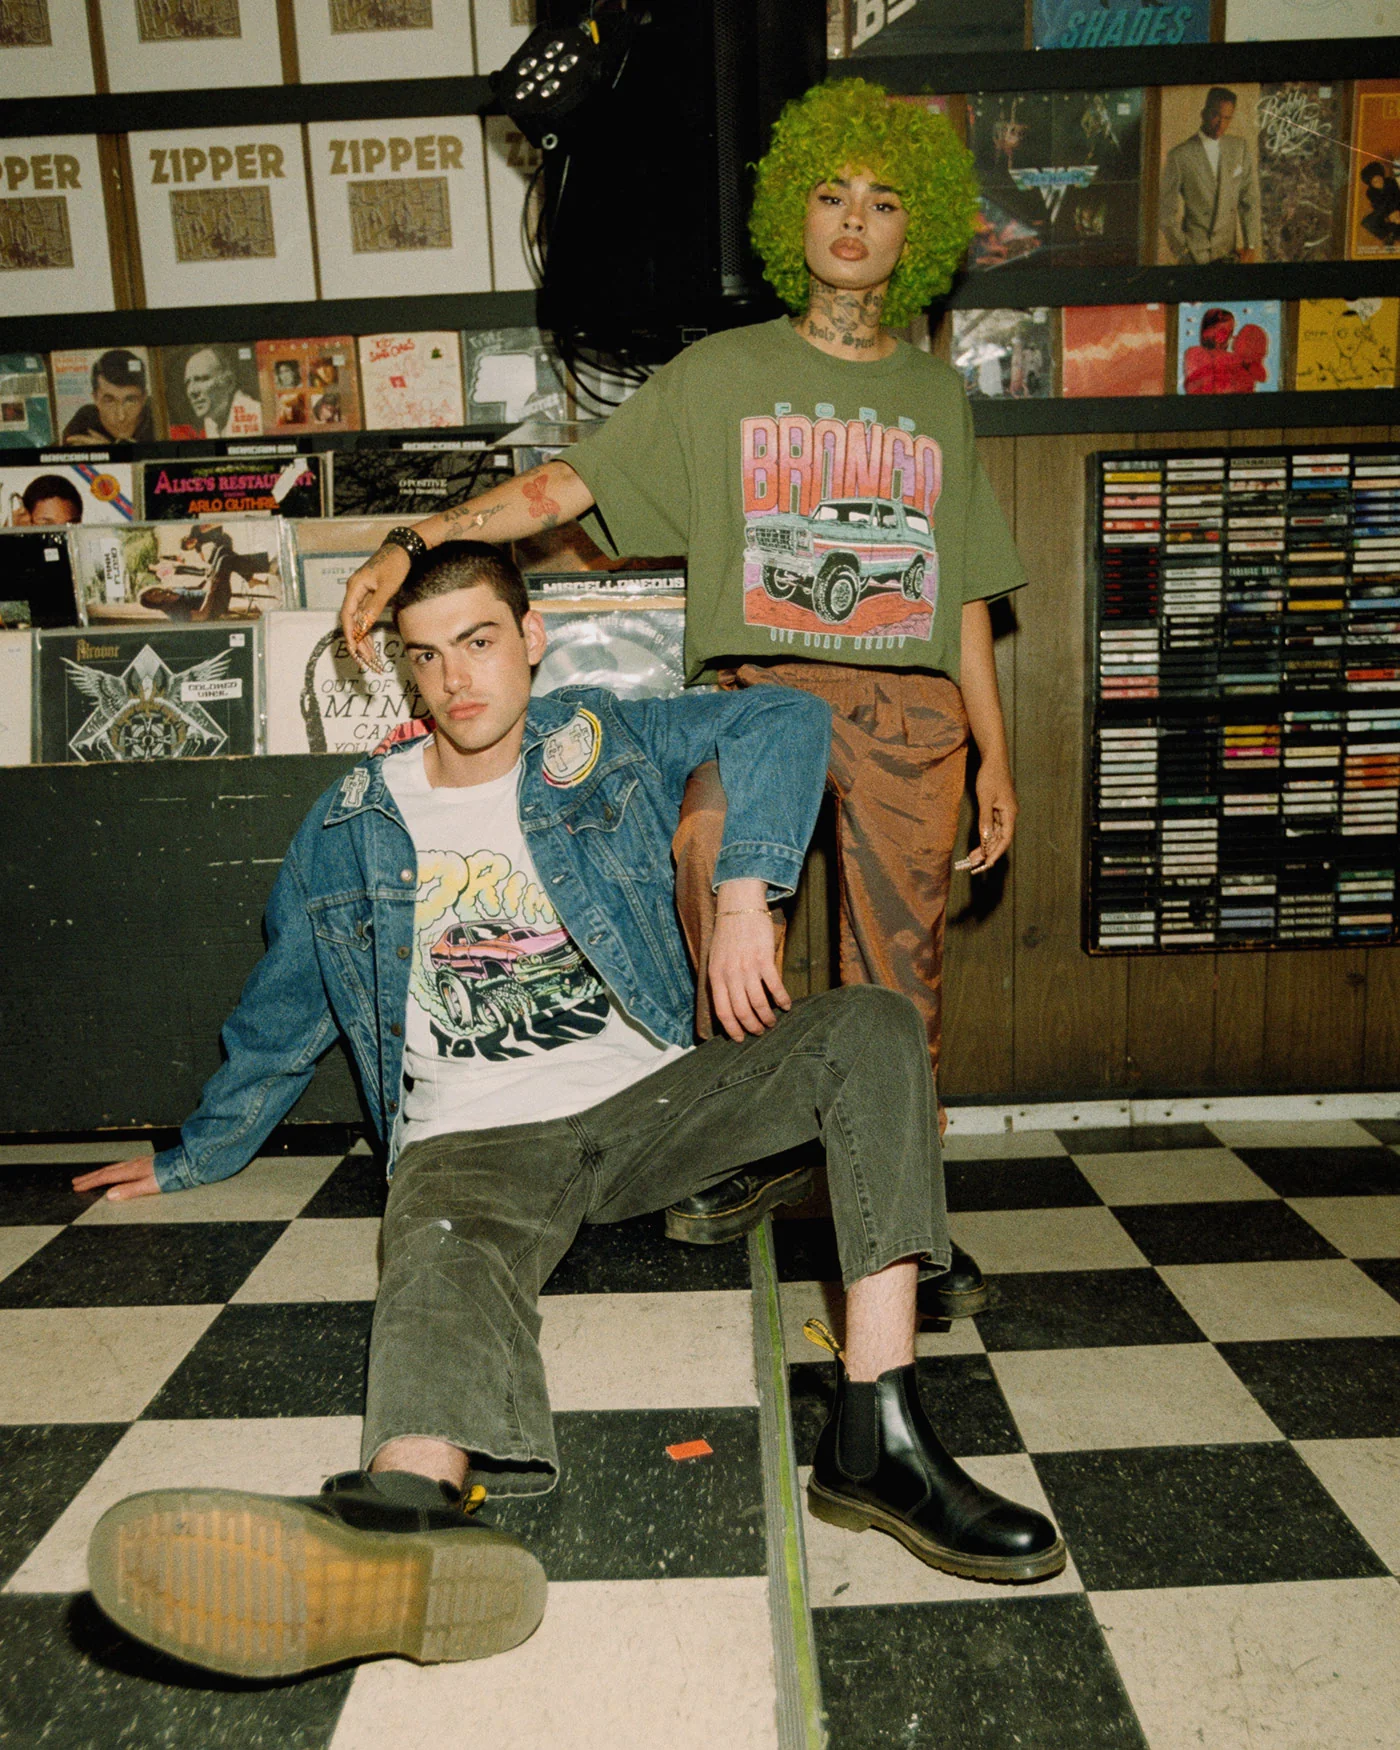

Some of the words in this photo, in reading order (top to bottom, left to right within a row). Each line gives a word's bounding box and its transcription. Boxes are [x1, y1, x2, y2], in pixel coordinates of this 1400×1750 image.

[1061, 5, 1193, 49] SHADES
[149, 143, 286, 185] ZIPPER
[329, 134, 465, 176] ZIPPER
[0, 153, 82, 191] PER
[154, 470, 216, 494] ALICE'S
[218, 471, 313, 491] RESTAUNT
[741, 415, 943, 530] BRONCO
[188, 498, 223, 513] ARLO
[225, 496, 280, 511] GUTHRIE
[543, 577, 685, 593] MISCELLANEOUS
[321, 679, 359, 693] OUT
[368, 679, 395, 693] OF
[404, 679, 421, 693] M
[324, 693, 433, 719] MIND
